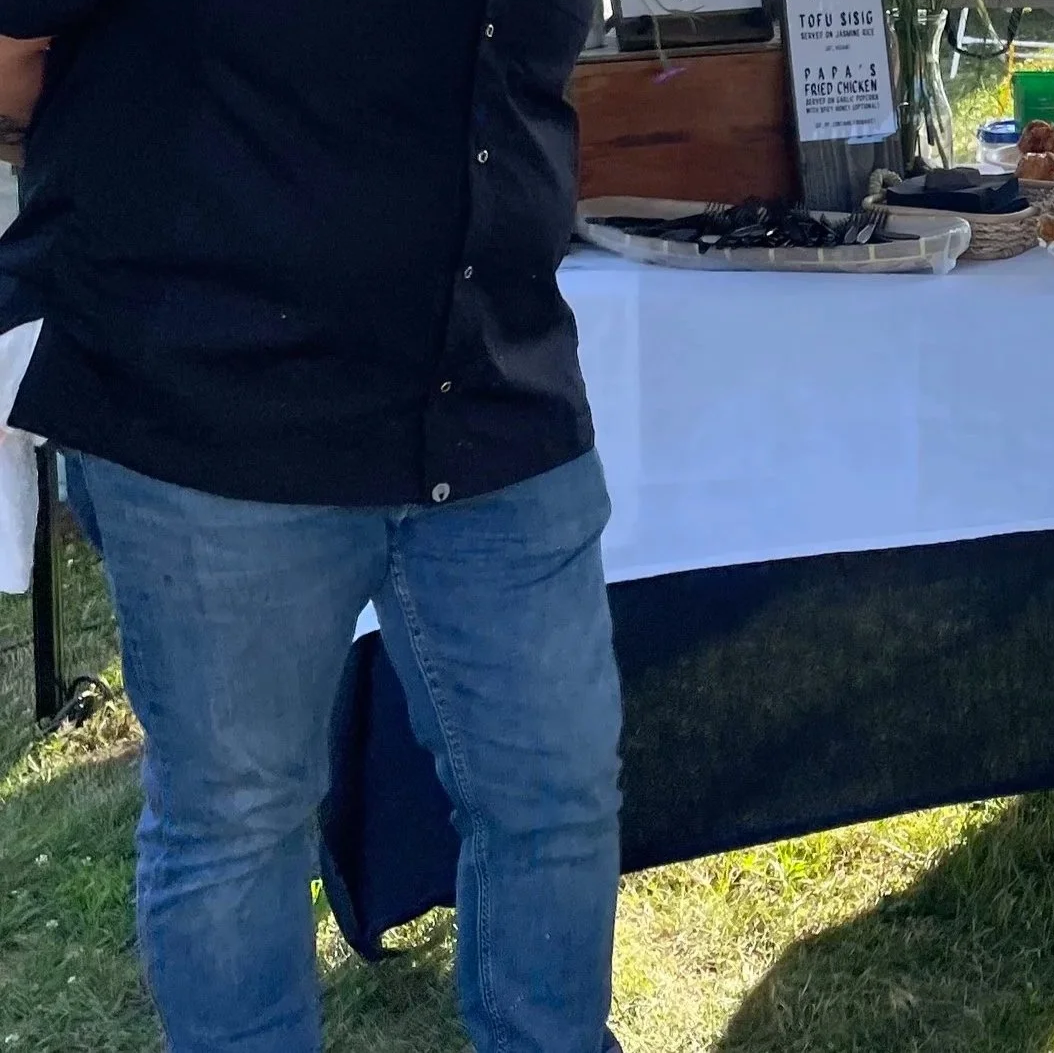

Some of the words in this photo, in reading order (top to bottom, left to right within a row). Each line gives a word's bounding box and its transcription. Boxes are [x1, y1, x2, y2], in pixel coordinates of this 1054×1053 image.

[799, 13, 833, 28] TOFU
[840, 10, 873, 26] SISIG
[800, 31, 823, 40] SERVED
[825, 30, 833, 38] ON
[804, 63, 876, 81] PAPA'S
[804, 82, 833, 96] FRIED
[837, 79, 877, 94] CHICKEN
